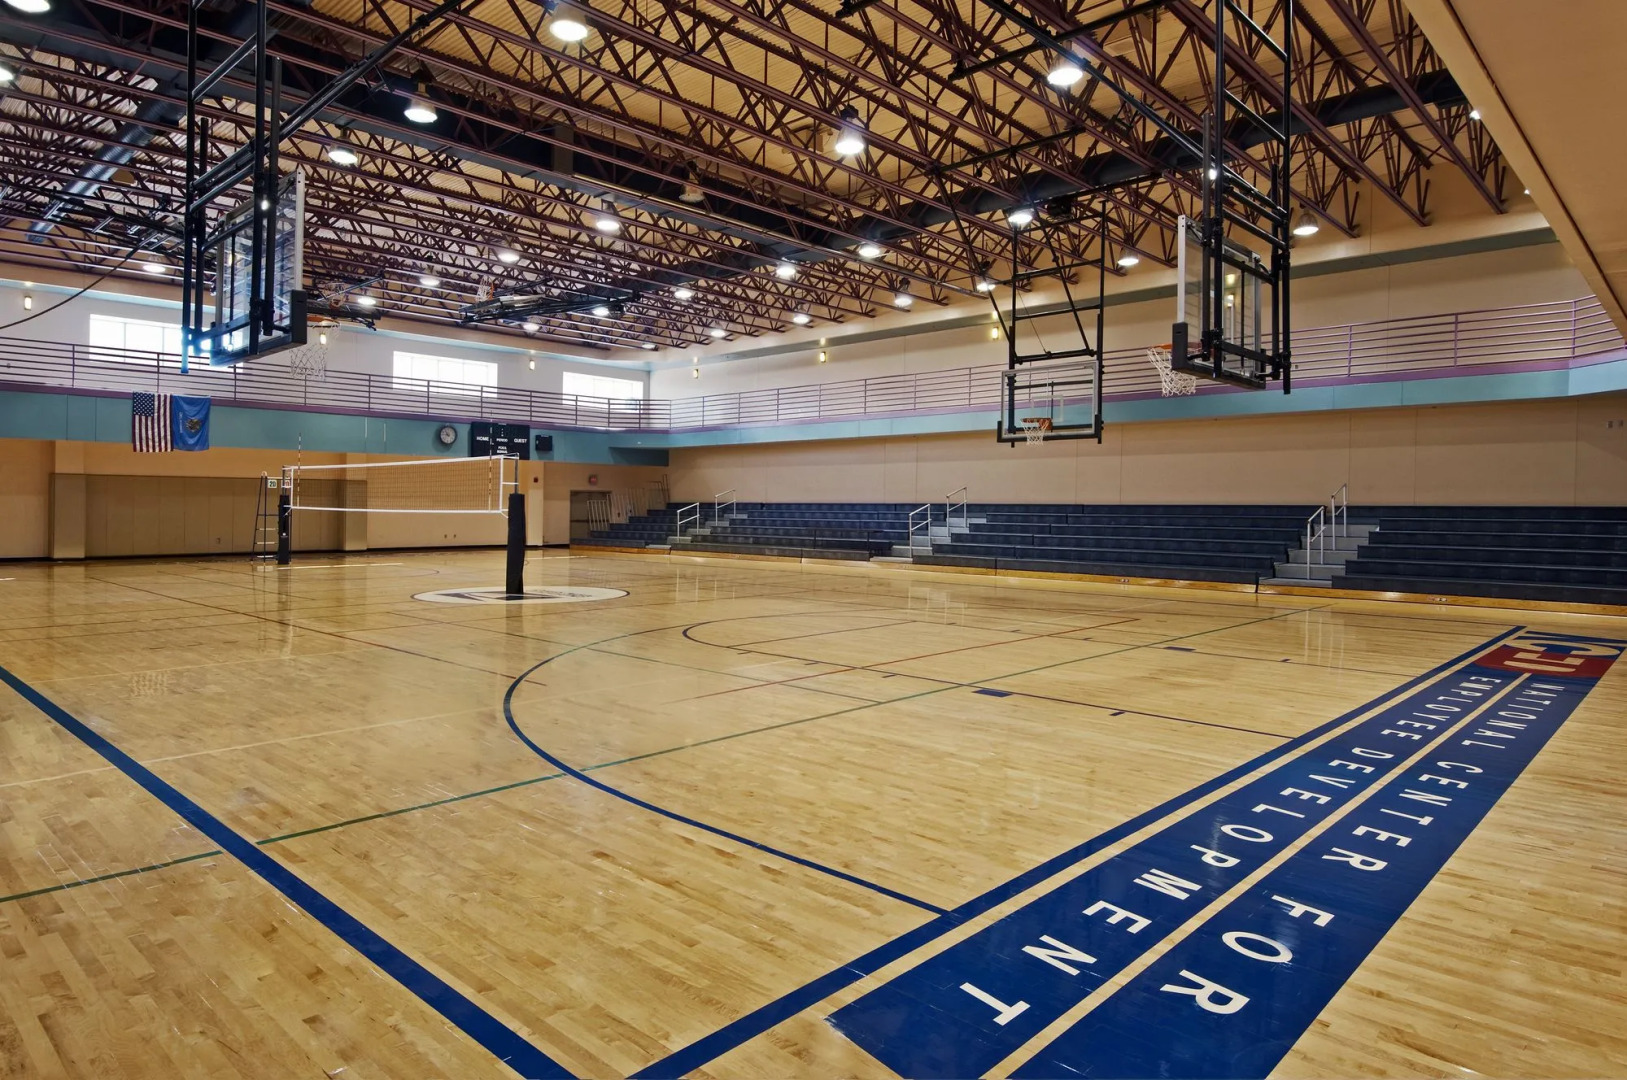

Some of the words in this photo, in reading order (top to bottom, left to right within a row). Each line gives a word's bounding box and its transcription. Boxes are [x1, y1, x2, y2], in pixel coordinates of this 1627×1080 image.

[1380, 676, 1502, 741] EMPLOYEE
[1461, 682, 1566, 749] NATIONAL
[1321, 761, 1484, 872] CENTER
[958, 746, 1395, 1026] DEVELOPMENT
[1160, 895, 1335, 1015] FOR
